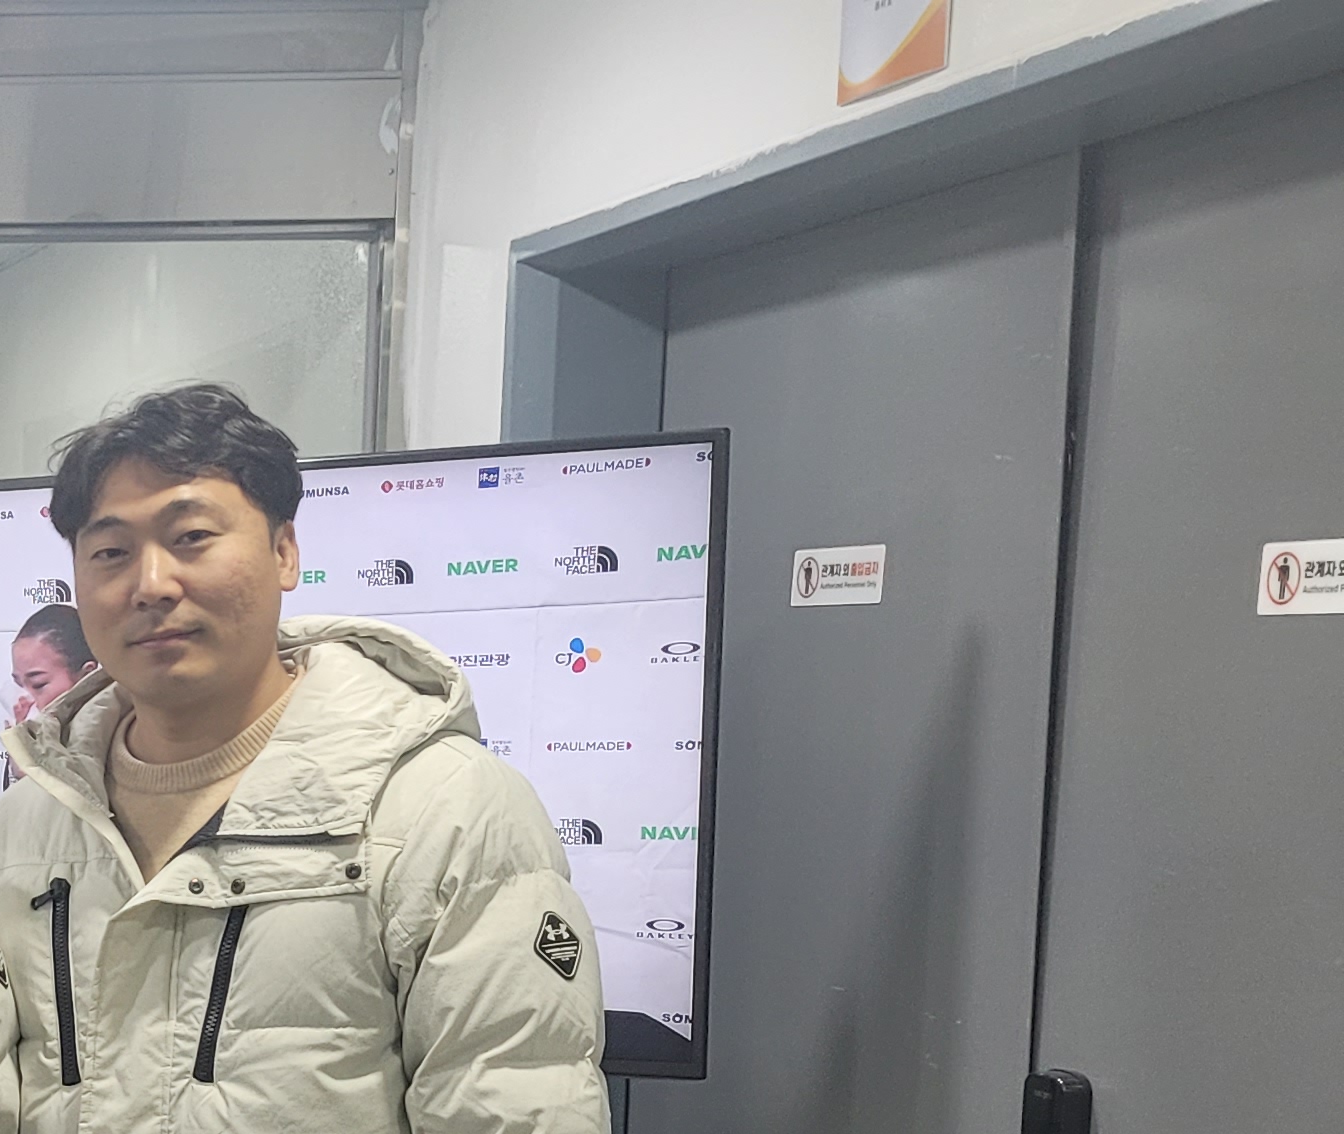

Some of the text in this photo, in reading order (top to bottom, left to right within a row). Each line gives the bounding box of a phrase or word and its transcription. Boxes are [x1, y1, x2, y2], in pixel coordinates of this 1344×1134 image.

[569, 458, 644, 475] PAULMADE
[396, 477, 445, 491] 롯데홈쇼핑
[573, 546, 597, 557] THE
[374, 559, 394, 568] THE
[555, 555, 596, 567] NORTH
[447, 558, 518, 576] NAVER
[566, 565, 596, 575] FACE
[358, 568, 394, 579] NORTH
[37, 579, 55, 587] THE
[368, 577, 394, 587] FACE
[23, 587, 55, 596] NORTH
[32, 595, 55, 604] FACE
[555, 653, 573, 667] CJ
[651, 656, 701, 664] OAKLE
[554, 742, 625, 752] PAULMADE
[560, 818, 581, 827] THE
[636, 931, 694, 940] OAKLEY
